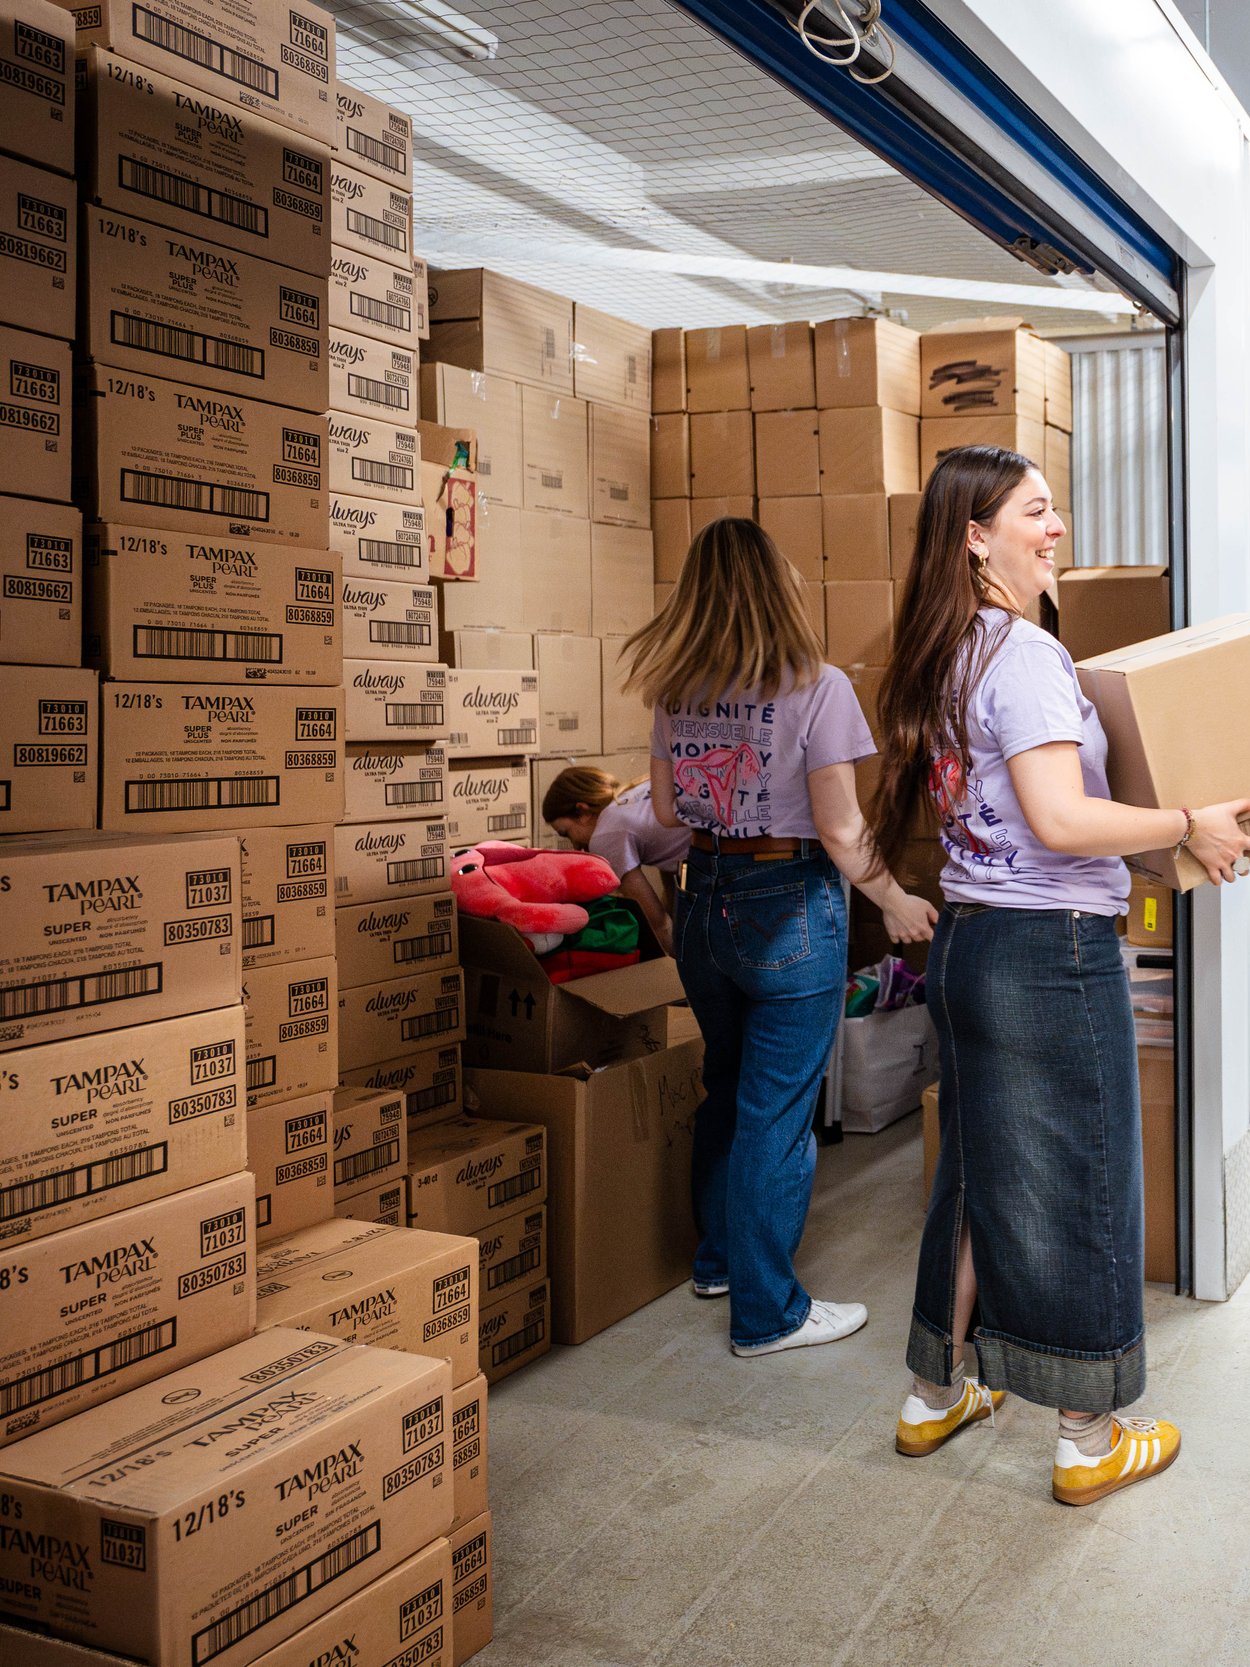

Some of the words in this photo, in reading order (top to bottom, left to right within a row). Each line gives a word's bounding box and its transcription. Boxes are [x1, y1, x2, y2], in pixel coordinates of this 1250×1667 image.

[294, 28, 324, 54] 71664
[20, 40, 60, 68] 71663
[283, 48, 326, 80] 80368859
[108, 62, 154, 95] 12/18's
[172, 91, 243, 132] TAMPAX
[175, 122, 201, 138] SUPER
[178, 129, 199, 143] PLUS
[287, 165, 318, 189] 71664
[275, 190, 320, 217] 80368859
[23, 211, 62, 236] 71663
[99, 219, 146, 247] 12/18's
[165, 240, 239, 275] TAMPAX
[169, 272, 196, 285] SUPER
[172, 279, 194, 290] PLUS
[285, 303, 315, 325] 71664
[273, 329, 317, 353] 80368859
[15, 378, 55, 401] 71663
[108, 378, 155, 402] 12/18's
[173, 394, 243, 421] TAMPAX
[177, 423, 204, 435] SUPER
[180, 431, 202, 440] PLUS
[286, 444, 317, 463] 71664
[275, 468, 318, 487] 80368859
[34, 538, 65, 551] 73010
[119, 536, 167, 555] 12/18's
[186, 544, 256, 565] TAMPAX
[31, 551, 68, 568] 71663
[8, 580, 68, 599] 80819662
[190, 575, 216, 583] SUPER
[192, 581, 214, 590] PLUS
[299, 584, 329, 599] 71664
[288, 608, 331, 623] 80368859
[353, 669, 405, 694] always
[46, 704, 80, 714] 73010
[114, 694, 162, 708] 12/18's
[181, 696, 255, 710] TAMPAX
[463, 685, 519, 715] always
[44, 716, 83, 731] 71663
[300, 724, 332, 737] 71664
[19, 748, 83, 763] 80819662
[288, 752, 333, 766] 80368859
[353, 751, 404, 775] always
[453, 774, 509, 801] always
[292, 845, 319, 857] 73010
[355, 832, 406, 853] always
[291, 857, 322, 874] 71664
[43, 876, 140, 902] TAMPAX
[191, 872, 225, 885] 73010
[191, 885, 228, 904] 71037
[280, 882, 325, 899] 80368859
[44, 921, 91, 936] SUPER
[168, 918, 229, 941] 80350783
[358, 912, 411, 933] always
[294, 982, 321, 996] 73010
[365, 988, 419, 1012] always
[293, 994, 324, 1013] 71664
[282, 1019, 326, 1038] 80368859
[196, 1044, 229, 1060] 73010
[50, 1058, 146, 1095] TAMPAX
[195, 1057, 232, 1080] 71037
[173, 1089, 233, 1119] 80350783
[51, 1109, 97, 1129] SUPER
[291, 1116, 320, 1131] 73010
[290, 1127, 322, 1149] 71664
[278, 1157, 325, 1180] 80368859
[456, 1153, 504, 1184] always
[205, 1212, 240, 1233] 73010
[204, 1226, 242, 1252] 71037
[59, 1236, 156, 1284] TAMPAX
[182, 1257, 243, 1294] 80350783
[438, 1273, 465, 1290] 73010
[60, 1292, 107, 1318] SUPER
[328, 1287, 396, 1327] TAMPAX
[436, 1284, 466, 1309] 71664
[425, 1310, 468, 1338] 80368859
[249, 1342, 331, 1384] 80350783
[183, 1391, 307, 1449] TAMPAX
[225, 1427, 286, 1458] SUPER
[406, 1415, 441, 1449] 71037
[88, 1449, 173, 1489] 12/18's
[274, 1440, 362, 1501] TAMPAX
[386, 1447, 441, 1494] 80350783
[172, 1489, 246, 1542] 12/18's
[275, 1504, 319, 1538] SUPER
[105, 1540, 141, 1565] 71037
[453, 1550, 482, 1581] 71664
[403, 1599, 439, 1637] 71037
